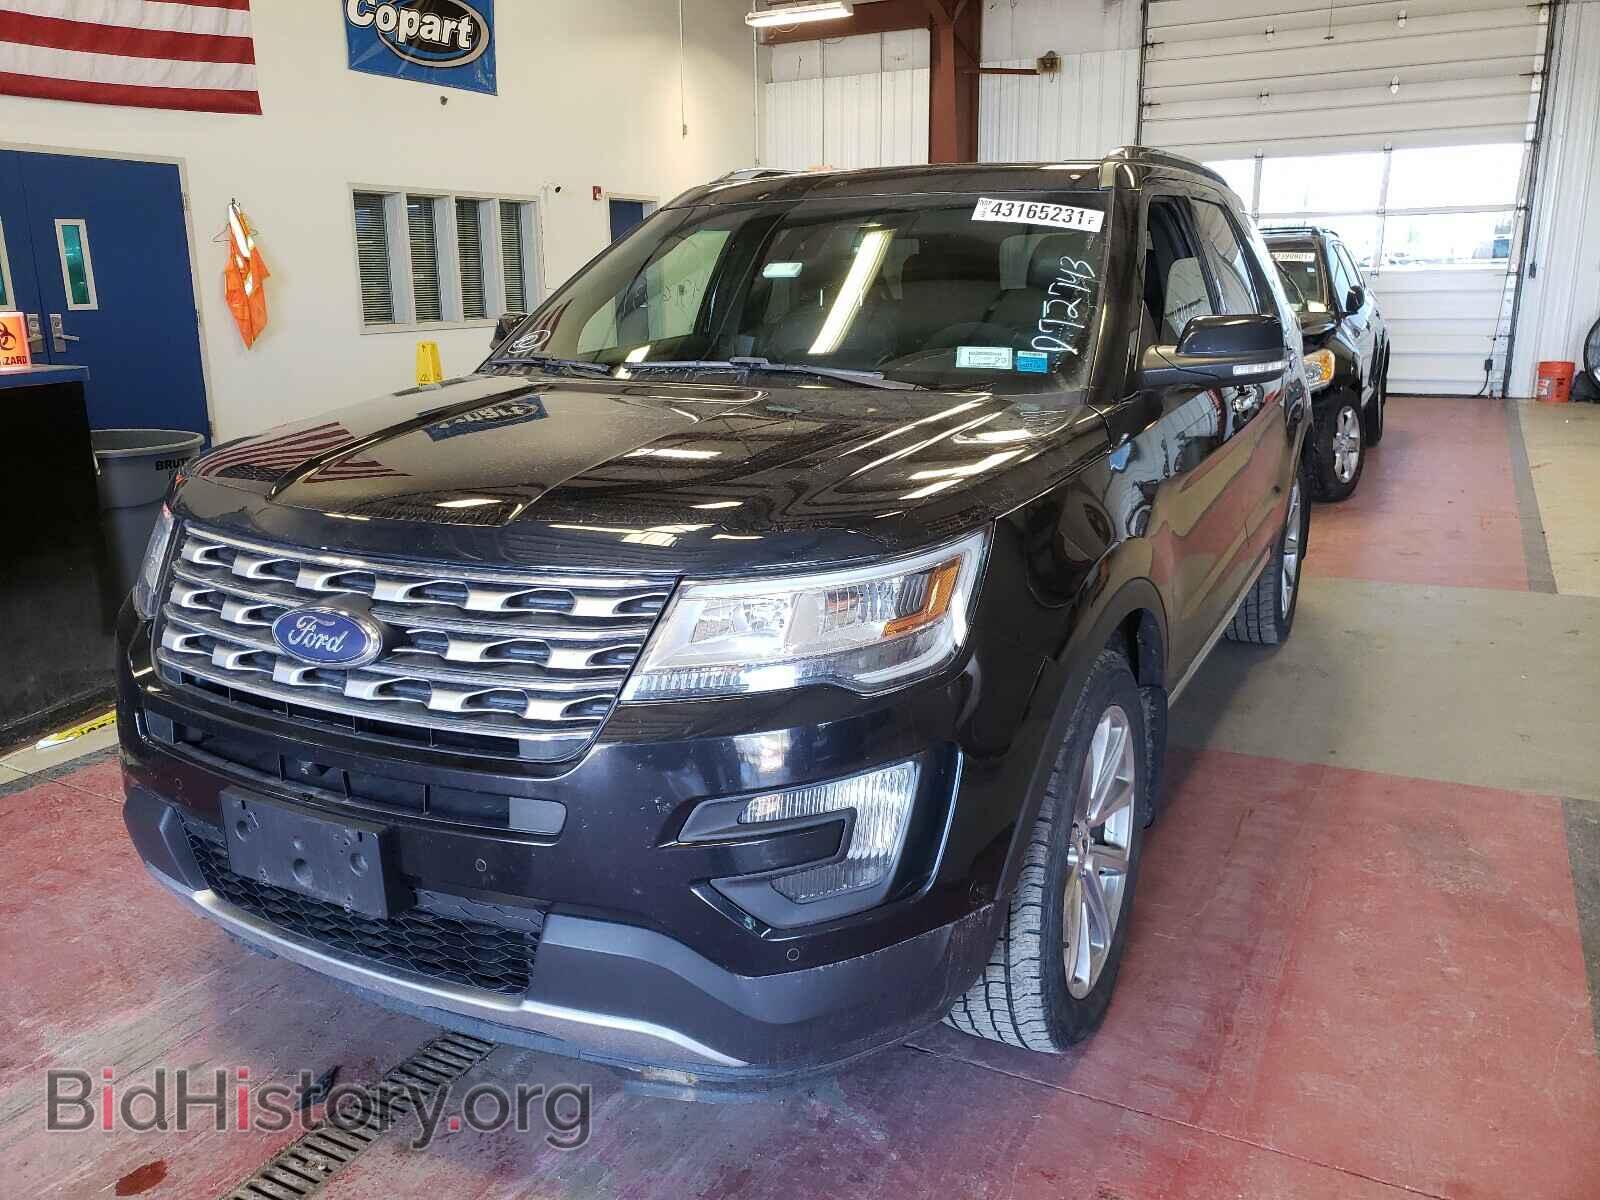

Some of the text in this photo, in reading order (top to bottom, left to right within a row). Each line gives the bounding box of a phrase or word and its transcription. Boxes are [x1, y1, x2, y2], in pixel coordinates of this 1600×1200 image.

[347, 0, 472, 50] Copart
[990, 202, 1085, 225] 43165231
[288, 615, 349, 653] Ford
